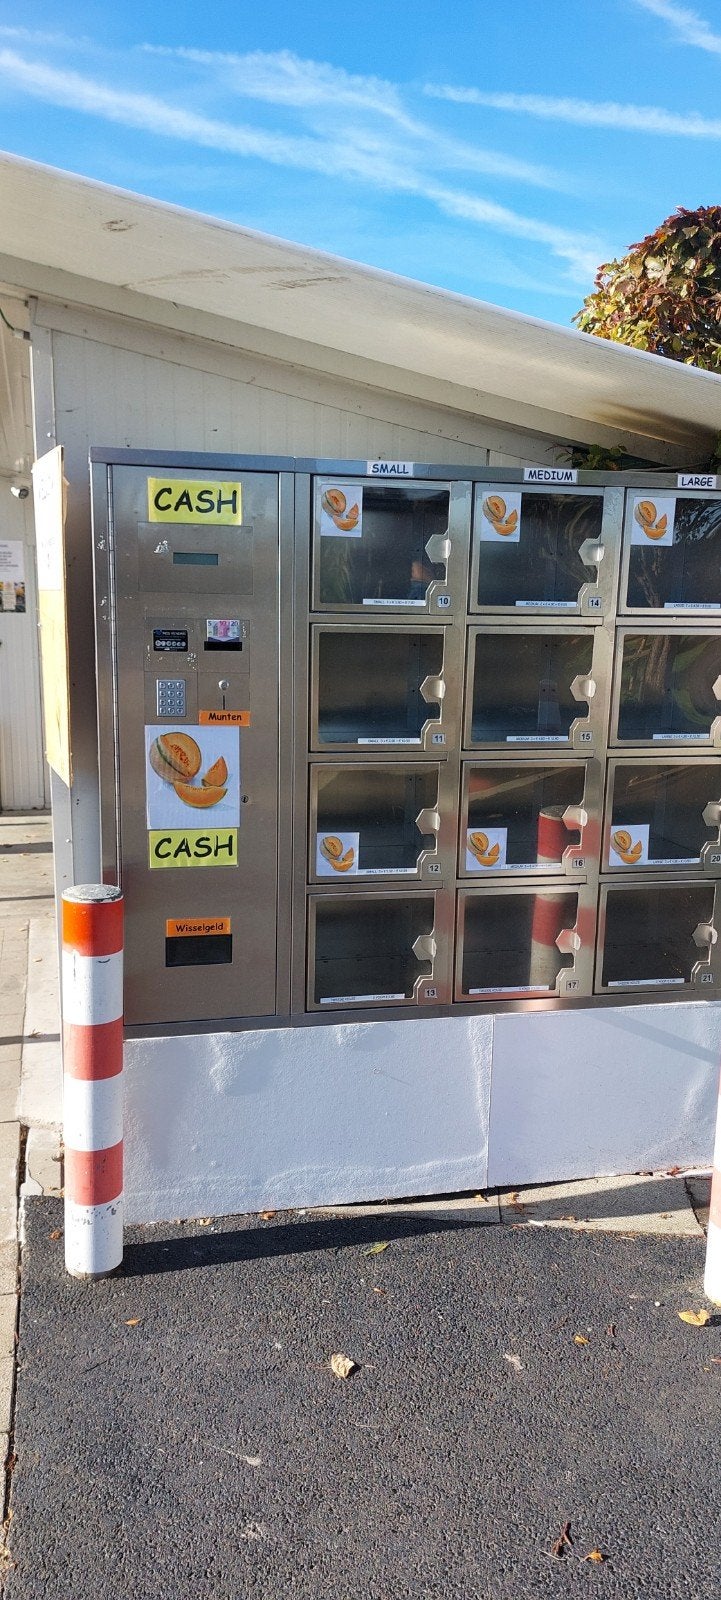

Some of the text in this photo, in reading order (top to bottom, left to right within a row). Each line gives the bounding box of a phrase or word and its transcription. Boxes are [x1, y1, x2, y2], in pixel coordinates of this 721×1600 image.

[371, 463, 409, 474] SMALL
[528, 469, 573, 481] MEDIUM
[681, 476, 714, 487] LARGE
[154, 487, 237, 514] CASH
[439, 597, 449, 605] 10
[590, 599, 599, 607] 14
[208, 712, 242, 721] Munten
[154, 835, 233, 859] CASH
[575, 859, 583, 867] 16
[711, 855, 721, 863] 20
[175, 922, 224, 933] Wisselgeld
[702, 974, 712, 982] 21
[567, 981, 577, 989] 17
[426, 989, 435, 997] 13
